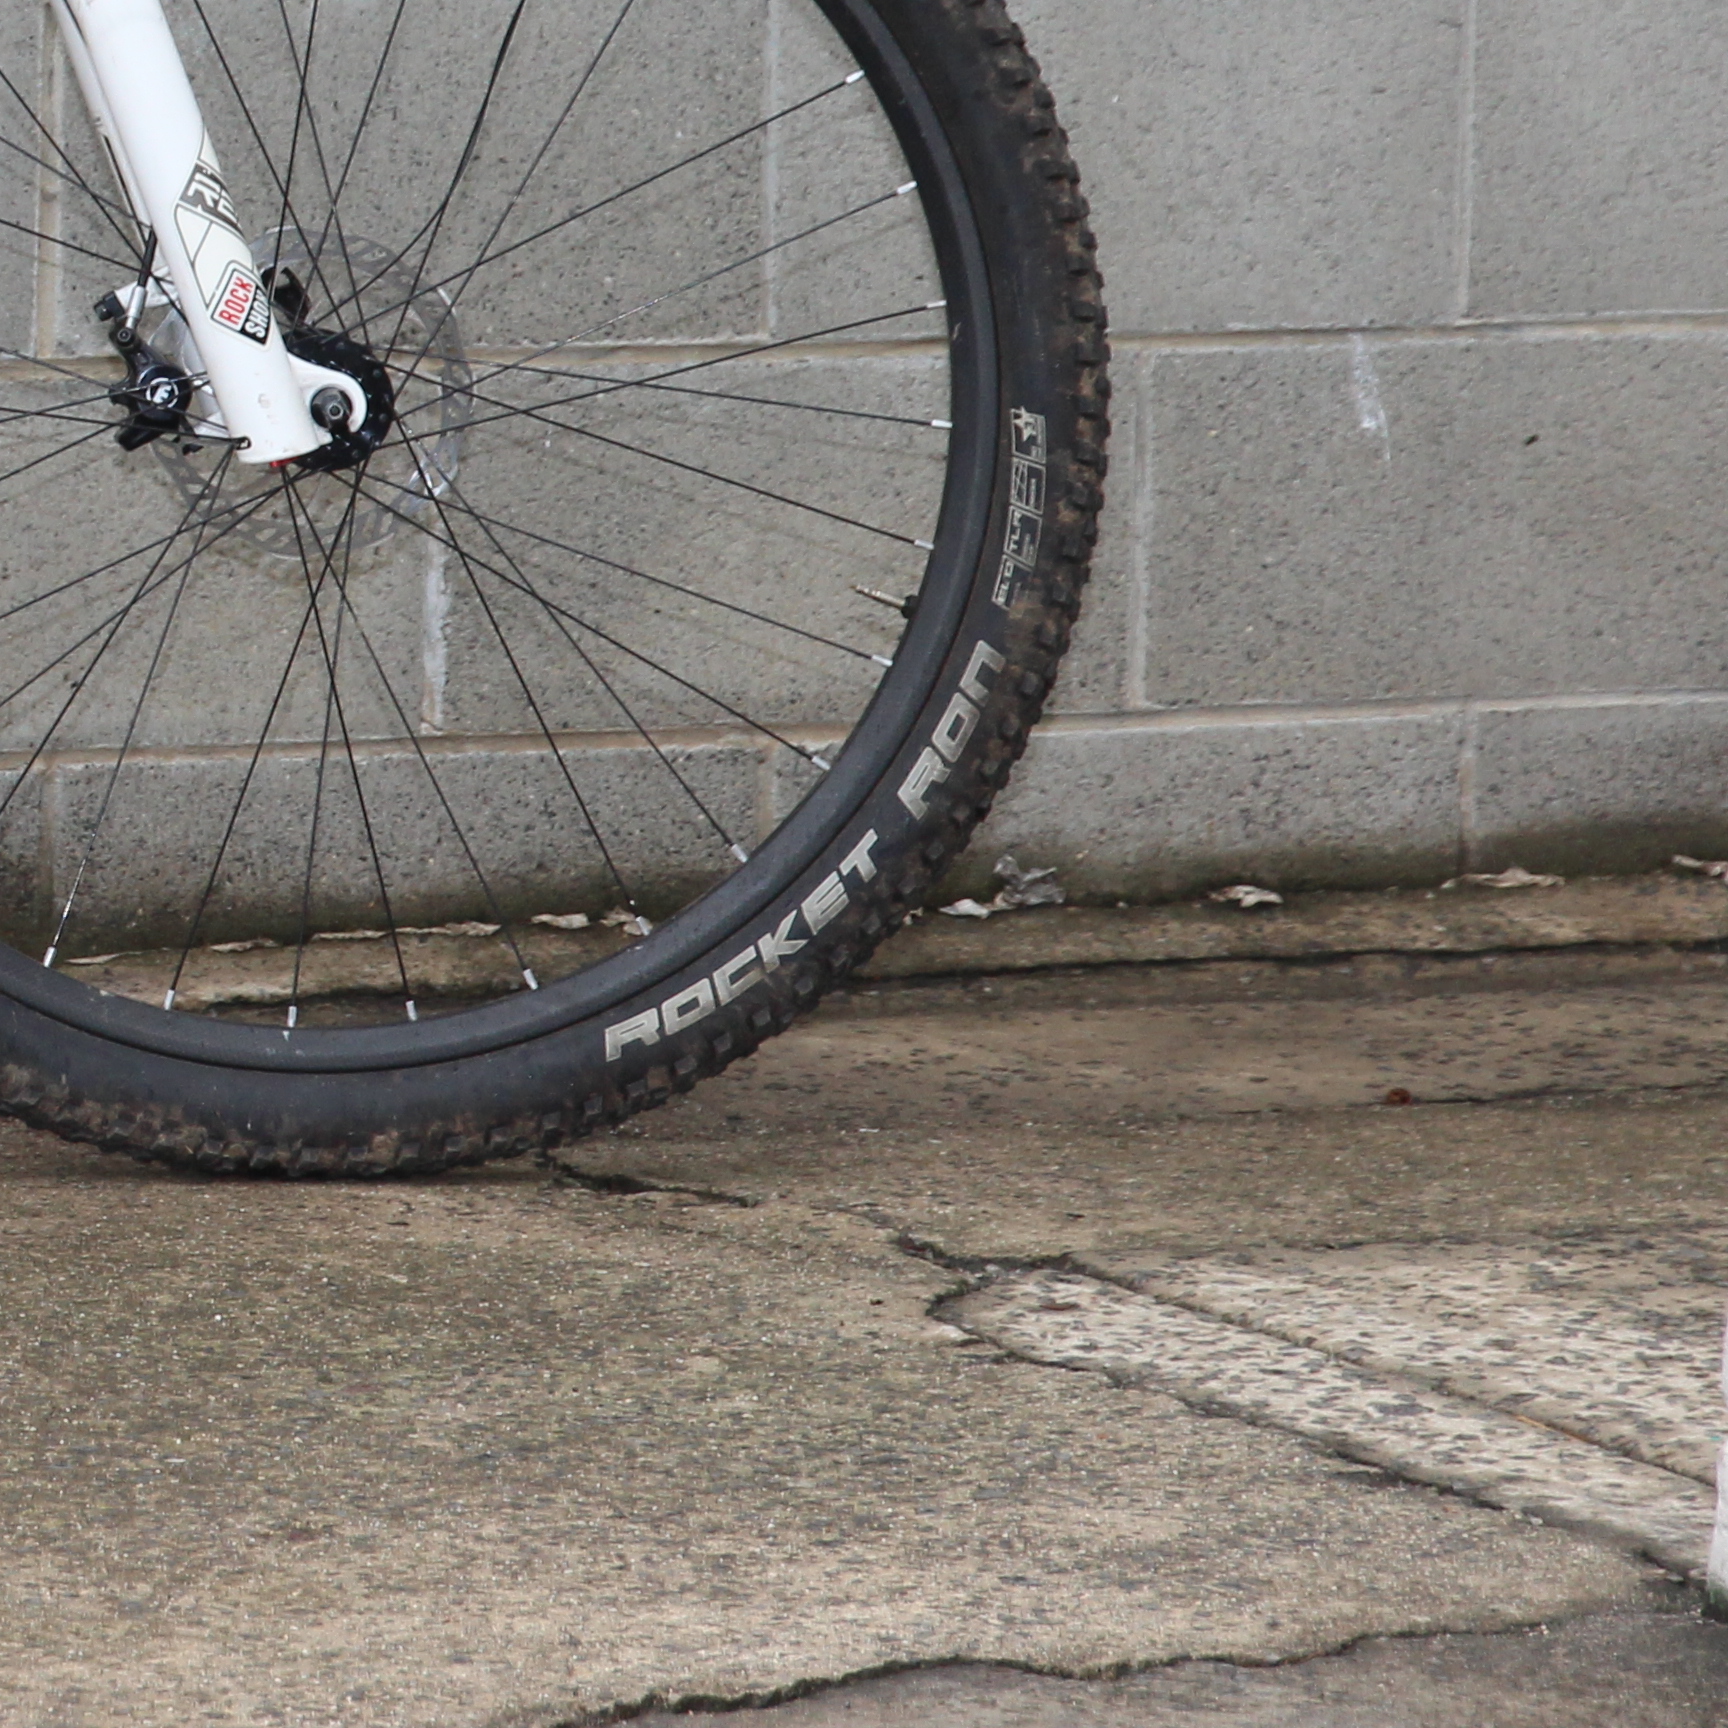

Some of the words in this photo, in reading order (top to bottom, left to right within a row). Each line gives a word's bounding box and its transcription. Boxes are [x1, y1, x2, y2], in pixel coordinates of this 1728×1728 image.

[219, 276, 254, 325] ROCK
[605, 829, 878, 1062] ROCKET
[897, 639, 1005, 820] RON
